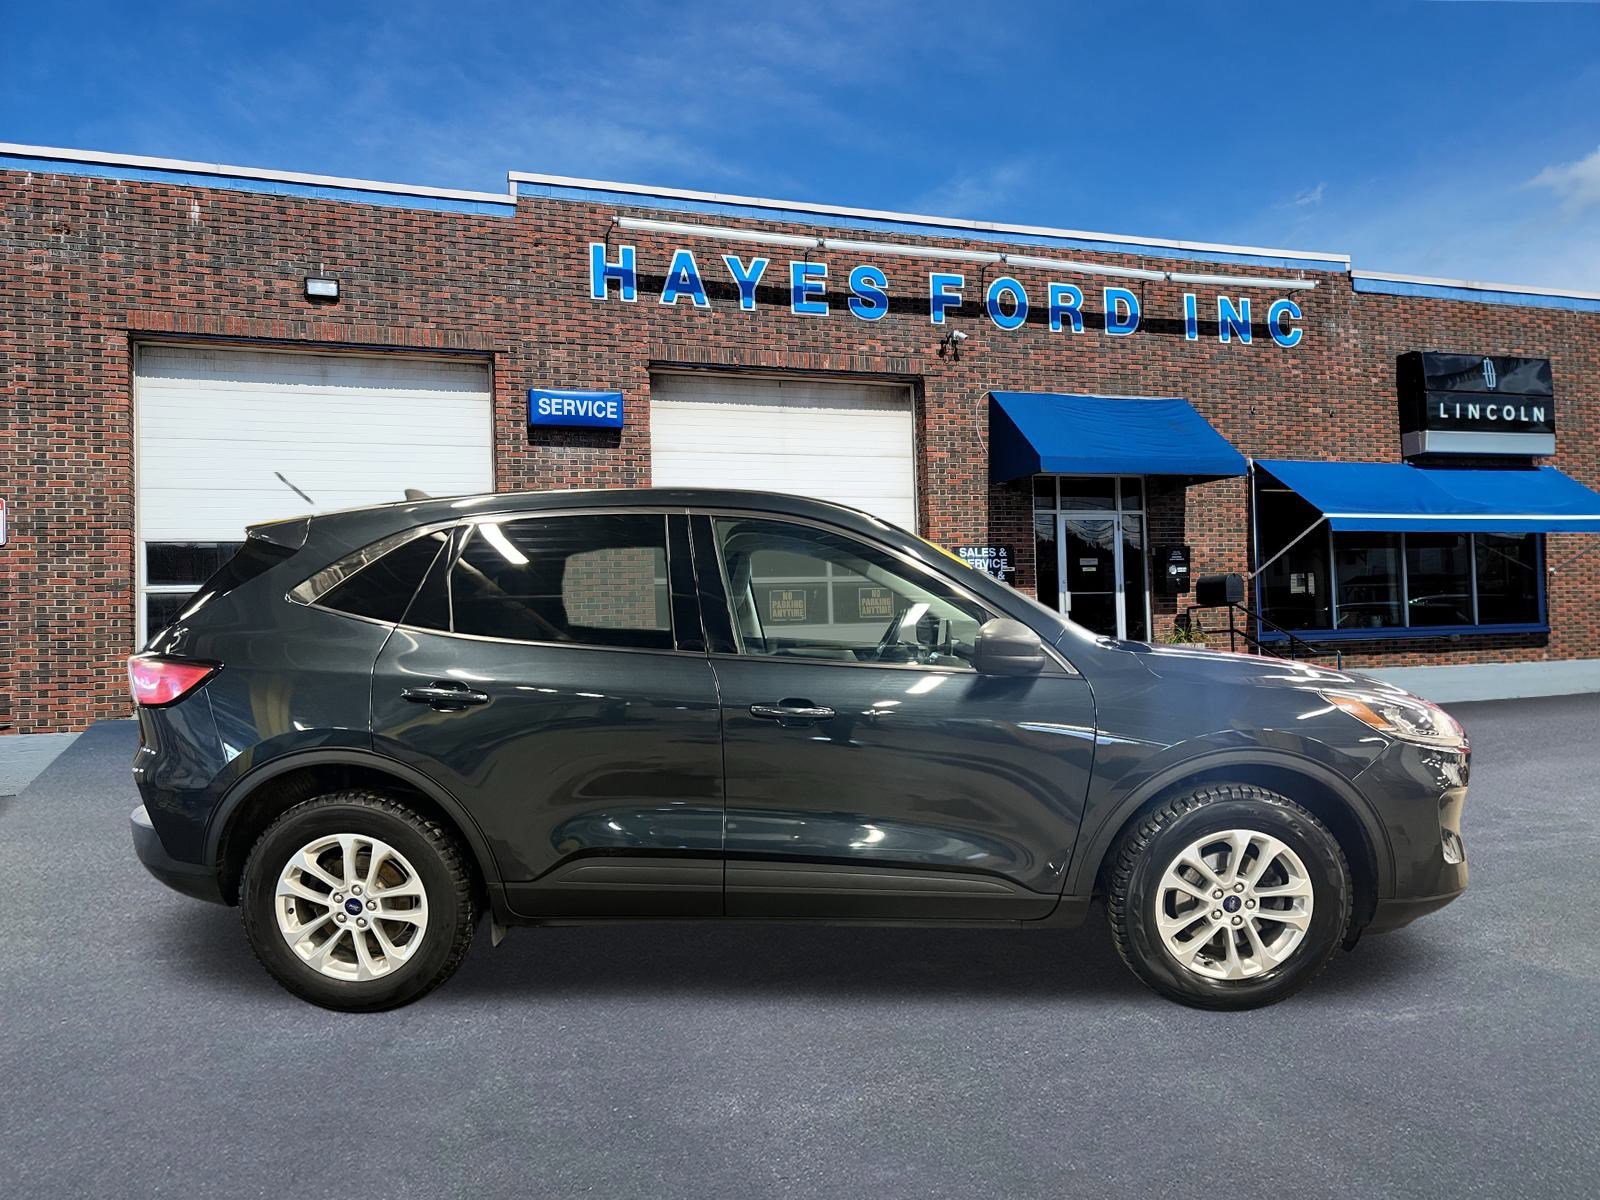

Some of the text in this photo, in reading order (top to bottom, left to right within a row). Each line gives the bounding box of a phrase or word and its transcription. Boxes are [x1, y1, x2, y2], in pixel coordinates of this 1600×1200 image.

[589, 242, 1303, 348] HAYES FORD INC
[538, 397, 618, 419] SERVICE
[1439, 402, 1546, 423] LINCOLN
[959, 547, 1008, 557] SALES &
[960, 558, 1008, 570] ERVICE
[782, 591, 792, 600] NO
[871, 589, 880, 598] NO
[772, 600, 804, 608] PARKING
[861, 597, 892, 606] PARKING
[772, 608, 805, 617] ANYTIME
